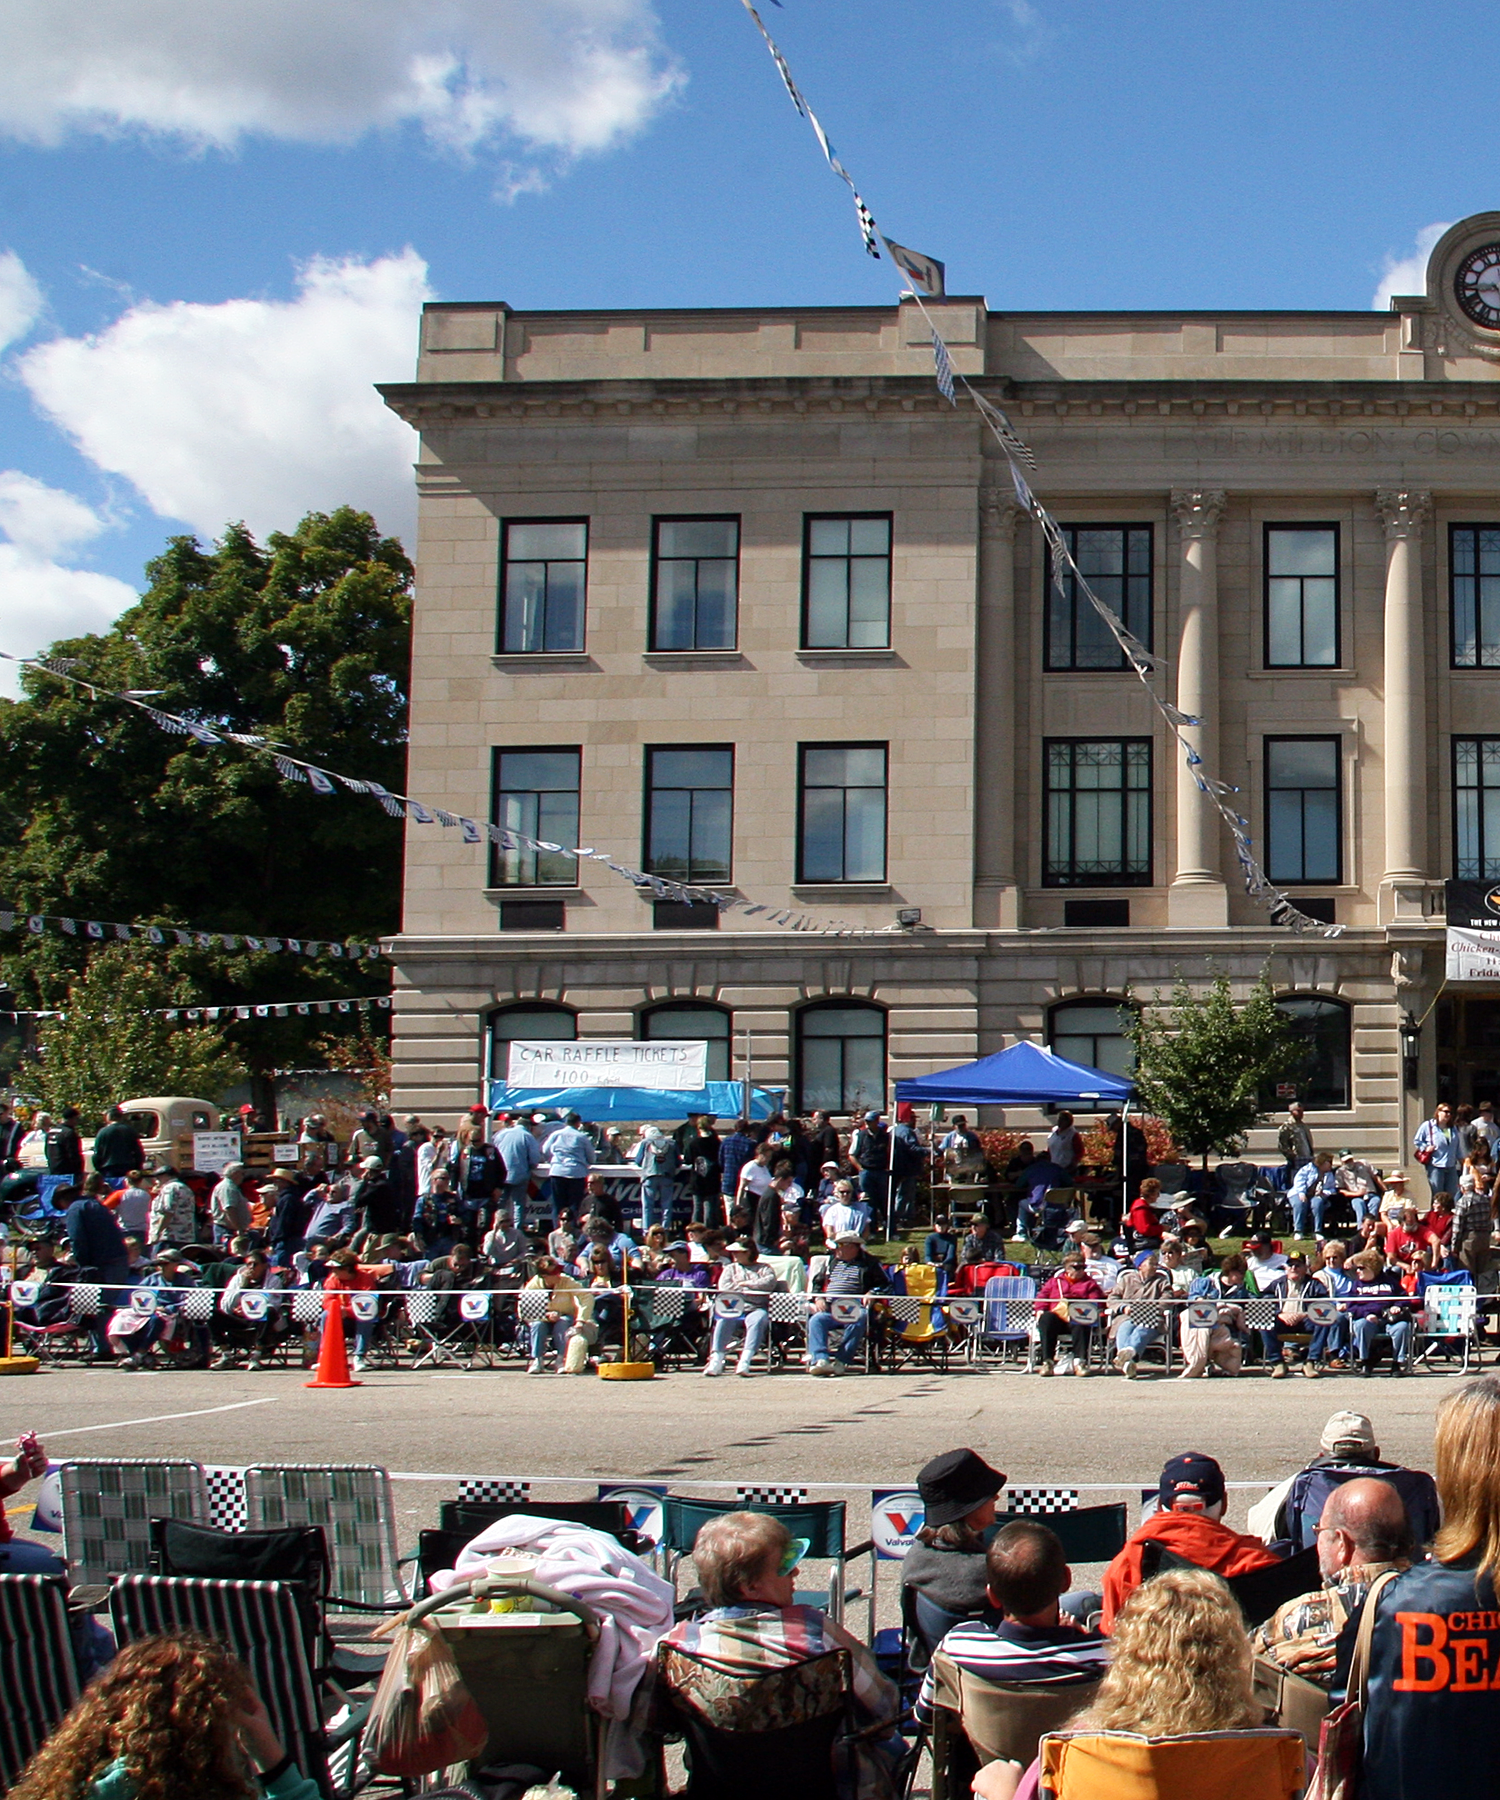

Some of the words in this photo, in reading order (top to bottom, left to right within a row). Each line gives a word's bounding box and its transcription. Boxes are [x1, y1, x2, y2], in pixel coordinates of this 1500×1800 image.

[520, 1047, 554, 1062] CAR
[562, 1047, 620, 1062] RAFFLE
[632, 1047, 688, 1062] TICKETS
